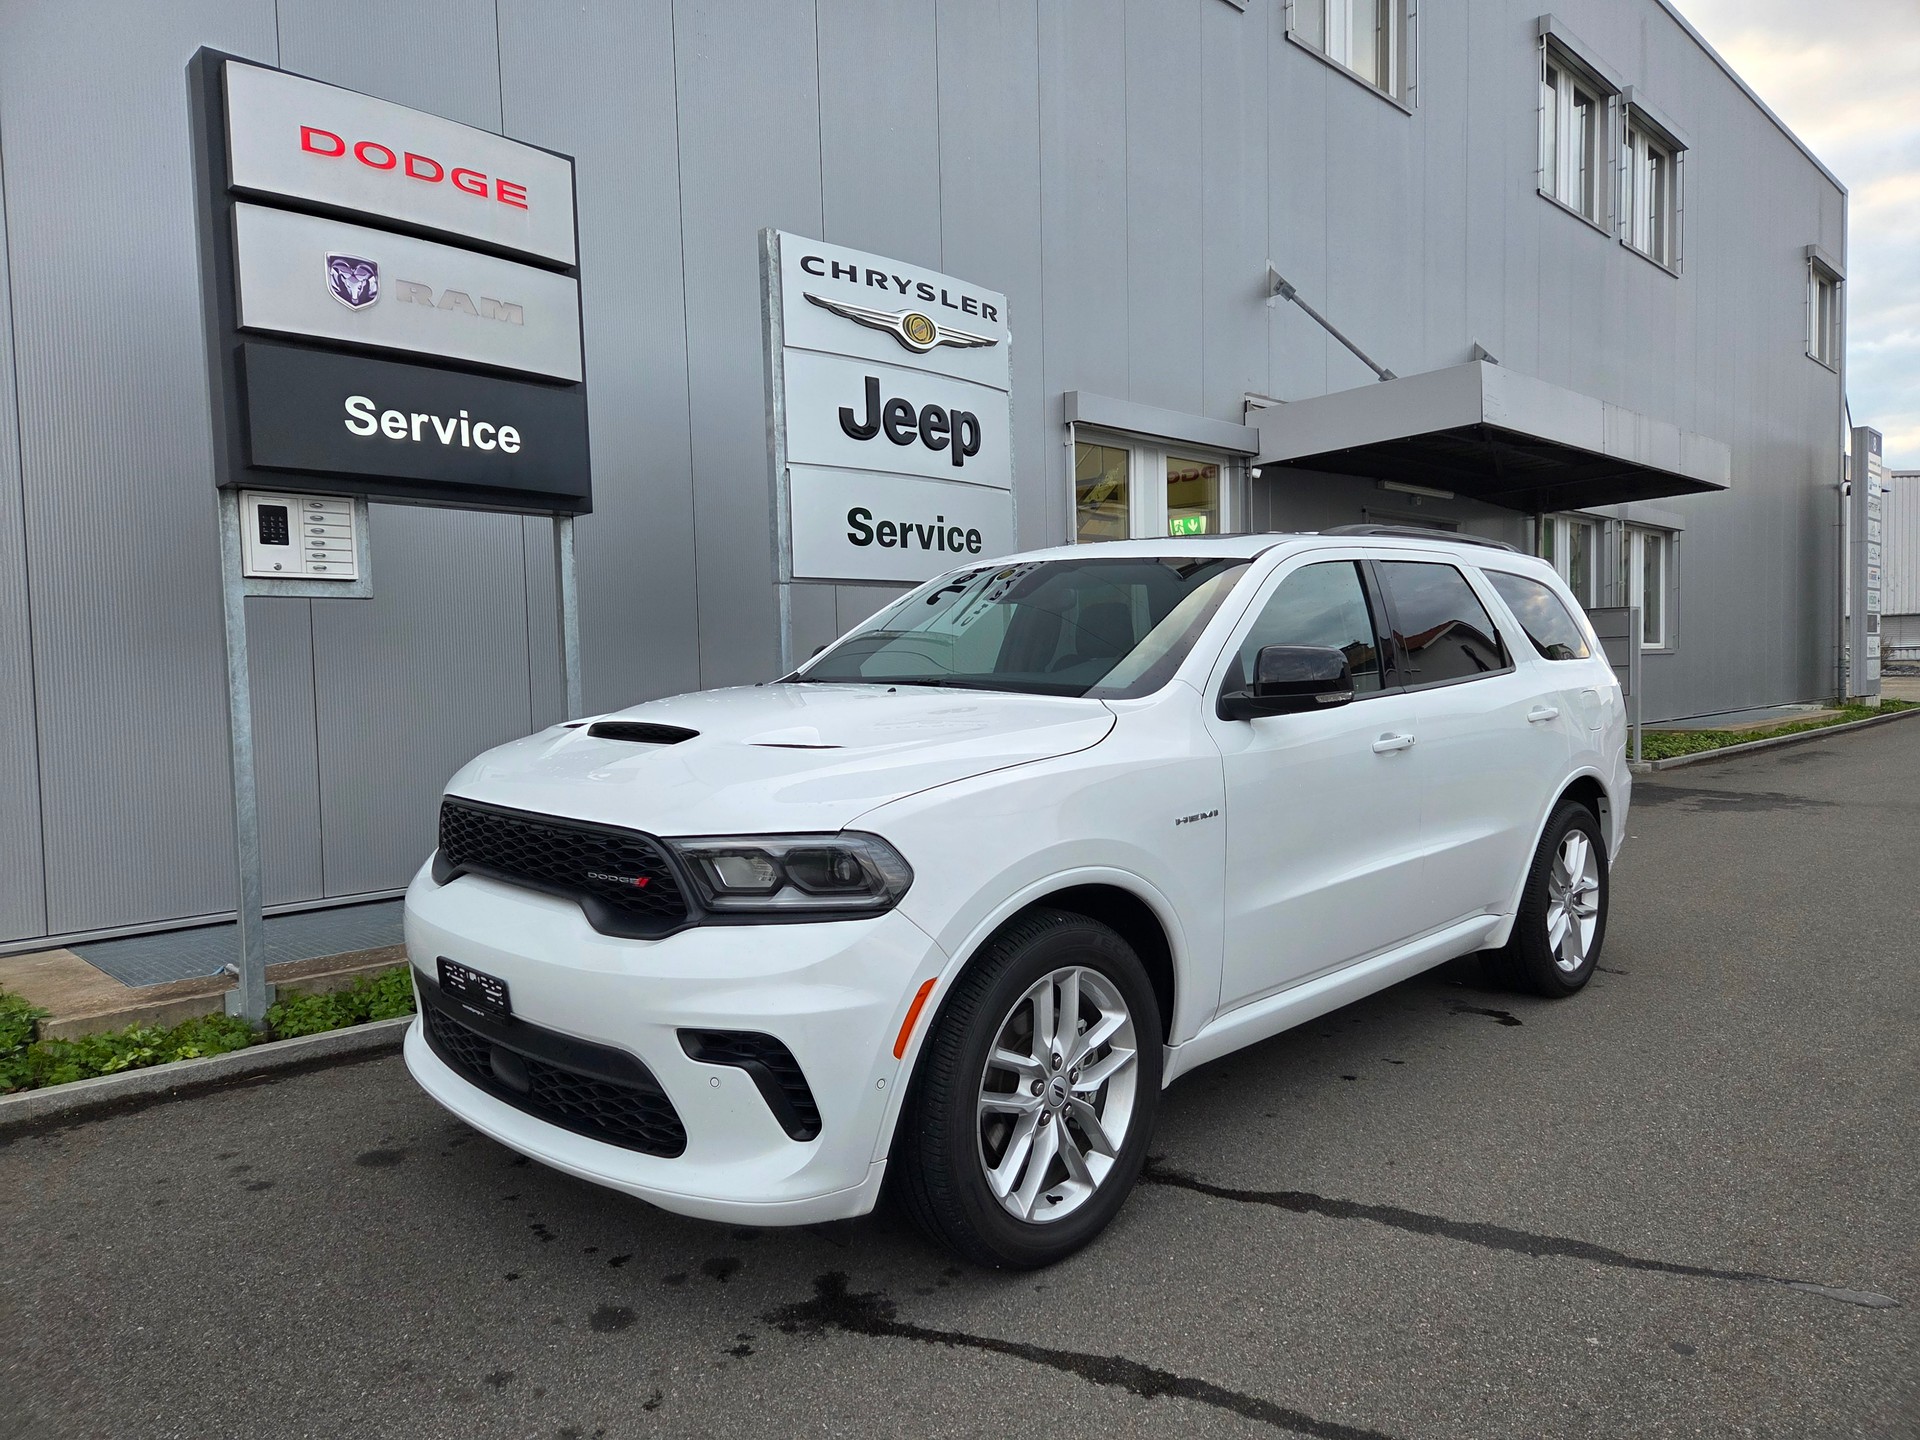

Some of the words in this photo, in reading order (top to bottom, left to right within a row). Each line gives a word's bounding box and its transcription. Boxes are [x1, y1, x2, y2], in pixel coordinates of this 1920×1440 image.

[299, 125, 529, 210] DODGE
[396, 279, 525, 326] RAM
[800, 255, 998, 323] CHRYSLER
[344, 395, 521, 454] Service
[838, 376, 982, 467] Jeep
[847, 506, 982, 554] Service
[1175, 809, 1219, 826] HEMI
[587, 871, 640, 885] DODGE
